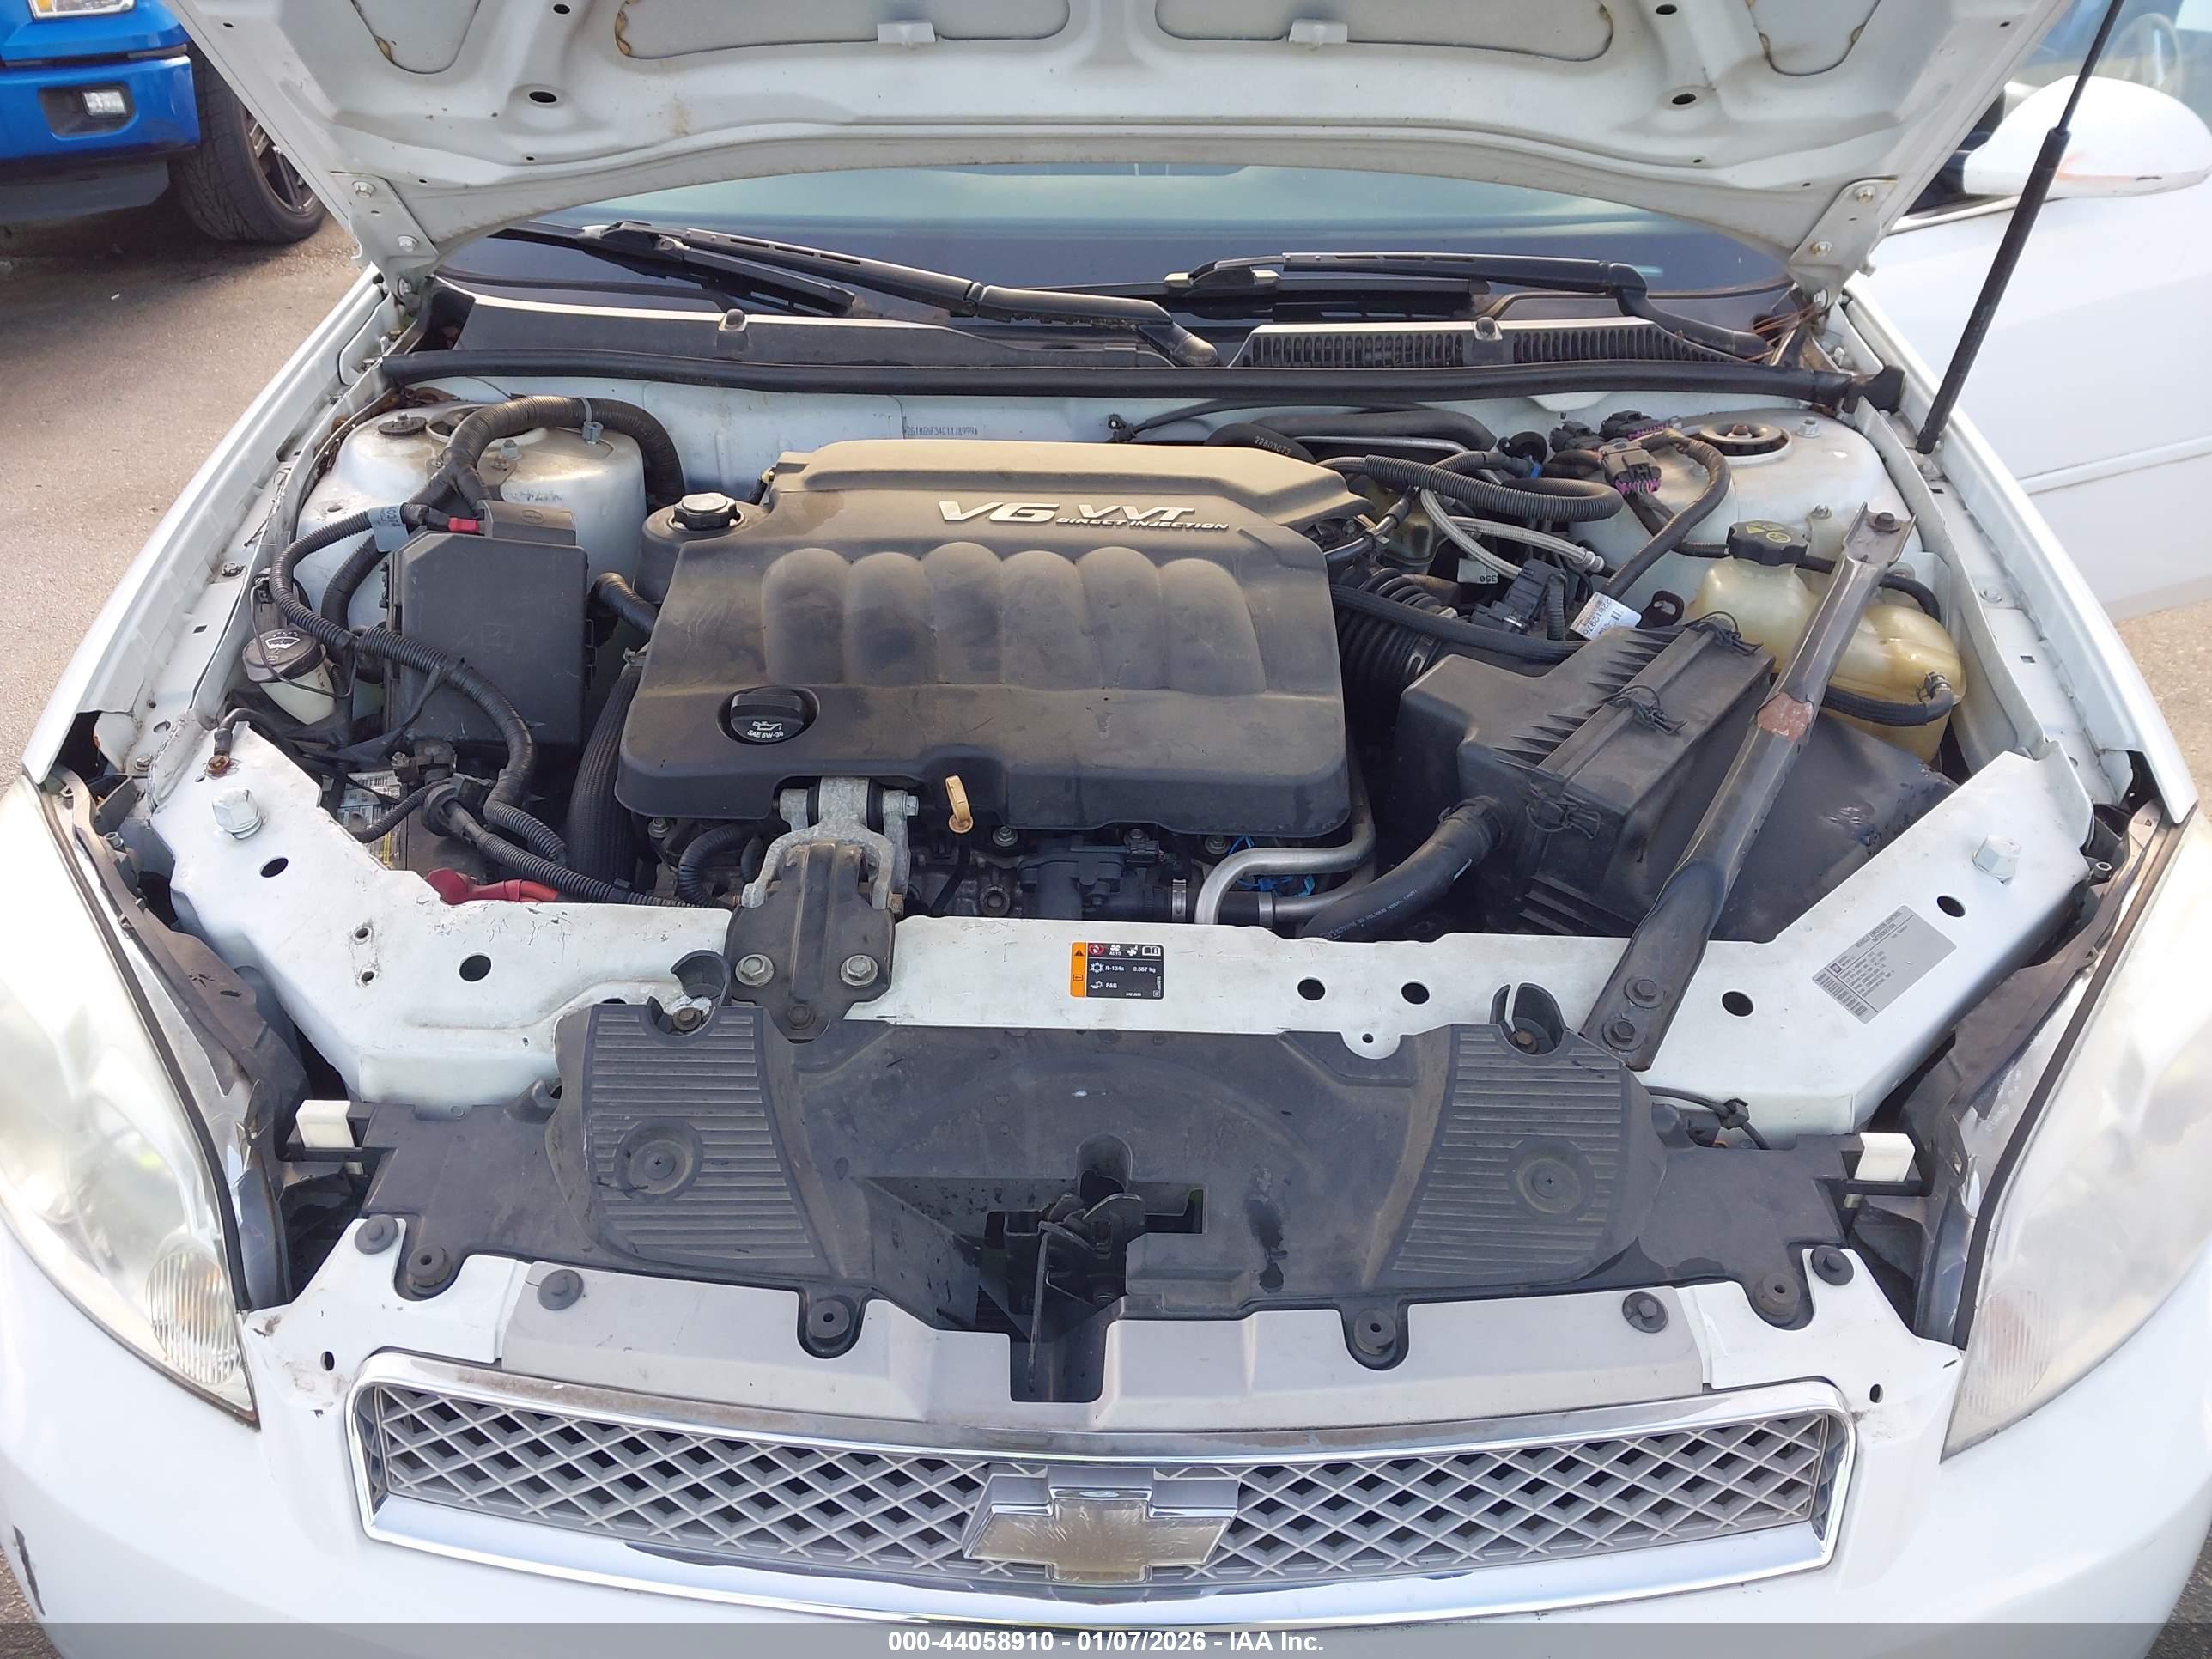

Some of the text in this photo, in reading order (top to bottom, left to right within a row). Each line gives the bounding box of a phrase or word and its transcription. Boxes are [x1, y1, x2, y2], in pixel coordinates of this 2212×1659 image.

[939, 501, 1195, 522] V6 VVT
[1055, 517, 1230, 530] DIRECT INJECTION
[747, 730, 761, 738] SAE
